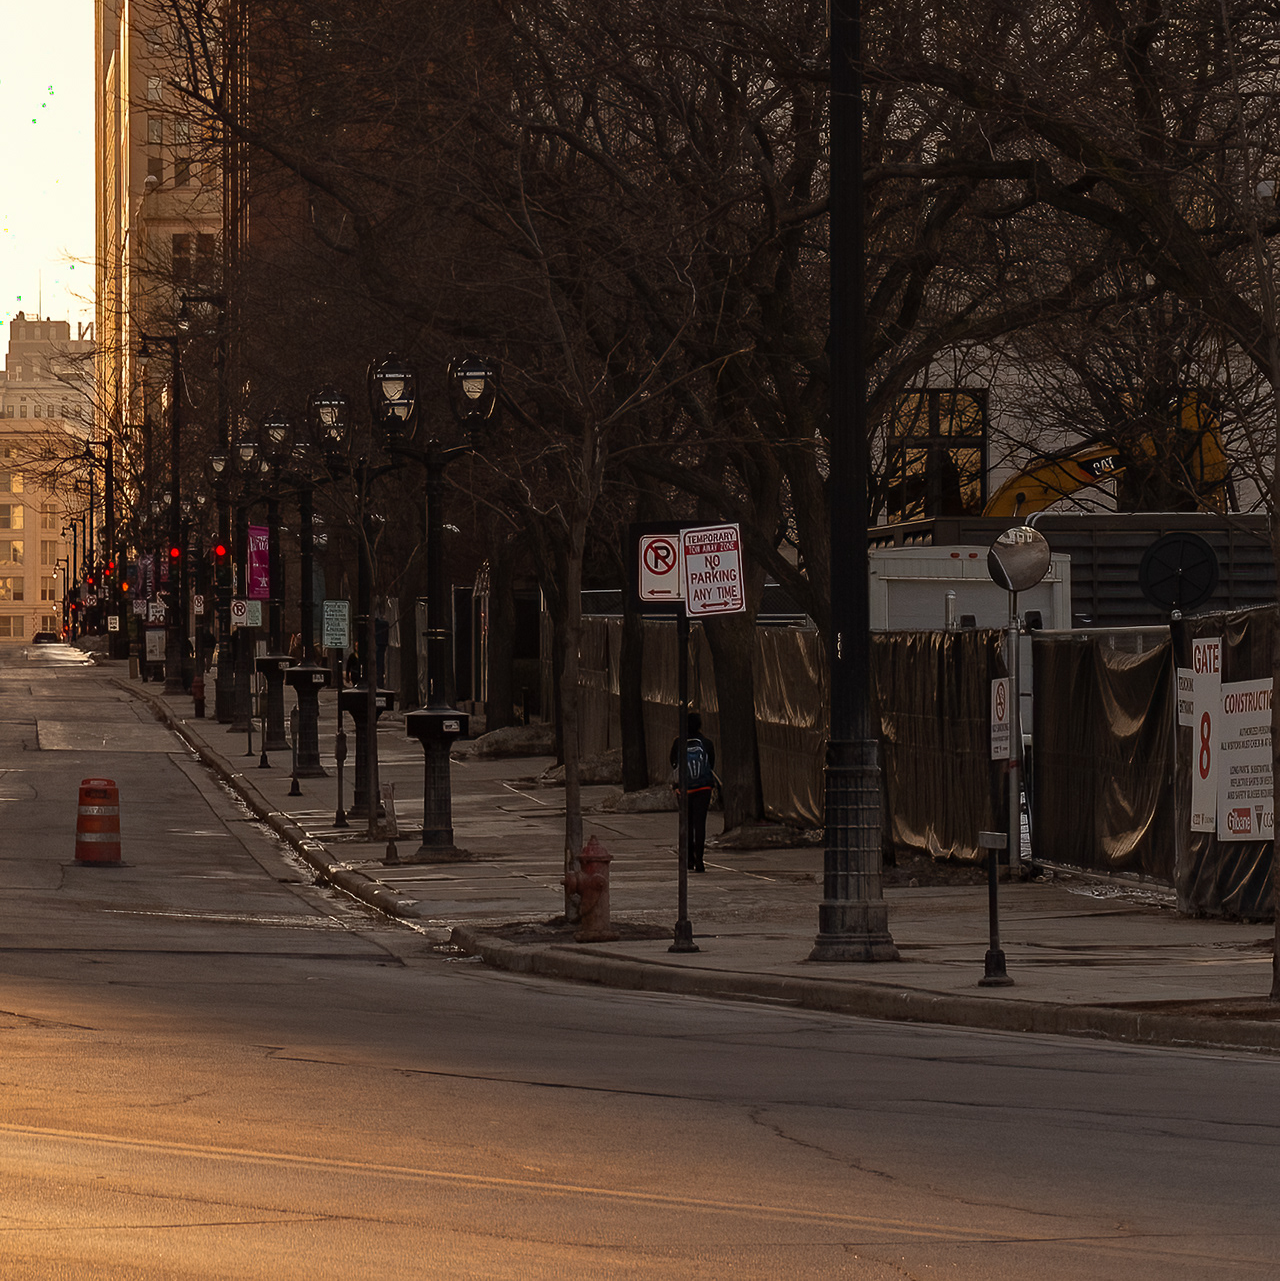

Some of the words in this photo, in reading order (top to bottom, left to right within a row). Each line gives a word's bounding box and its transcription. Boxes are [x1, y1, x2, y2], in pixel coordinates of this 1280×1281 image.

[687, 532, 735, 545] TEMPORARY
[702, 543, 718, 553] AWAY
[720, 541, 735, 551] ZONE
[704, 554, 721, 569] NO
[690, 568, 737, 585] PARKING
[693, 587, 713, 601] ANY
[717, 585, 738, 599] TIME
[1194, 644, 1219, 674] GATE
[1199, 711, 1211, 780] 8
[1227, 811, 1251, 831] Gilbane
